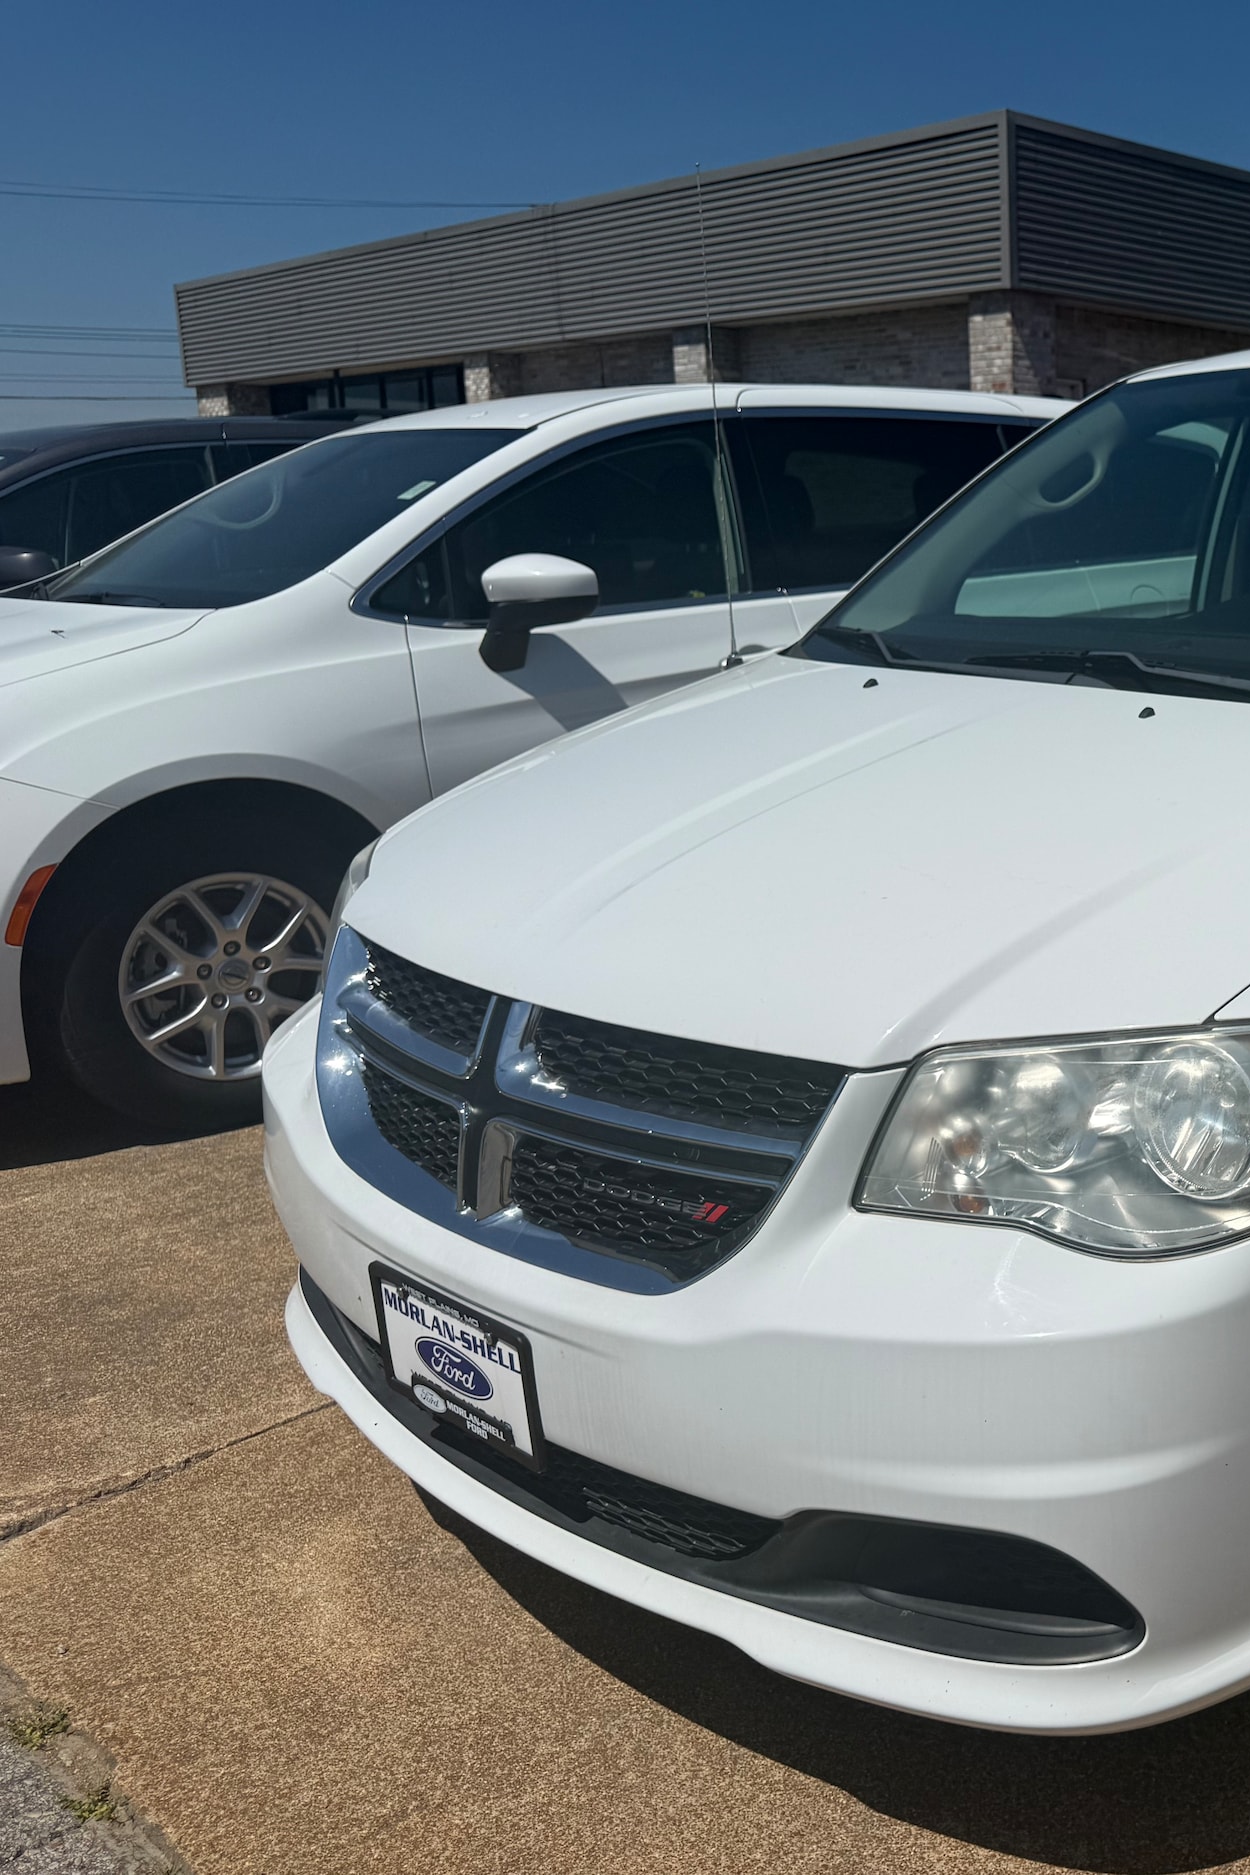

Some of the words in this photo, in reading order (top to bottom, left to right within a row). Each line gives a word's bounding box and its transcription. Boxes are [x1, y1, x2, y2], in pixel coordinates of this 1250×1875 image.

[583, 1177, 707, 1216] DODGE
[402, 1283, 426, 1301] WEST
[463, 1314, 480, 1328] MO
[383, 1287, 521, 1375] MORLAN-SHELL
[431, 1344, 475, 1391] Ford
[420, 1388, 440, 1408] Ford
[446, 1400, 506, 1442] MORLAN-SHELL
[466, 1420, 488, 1440] FORD
